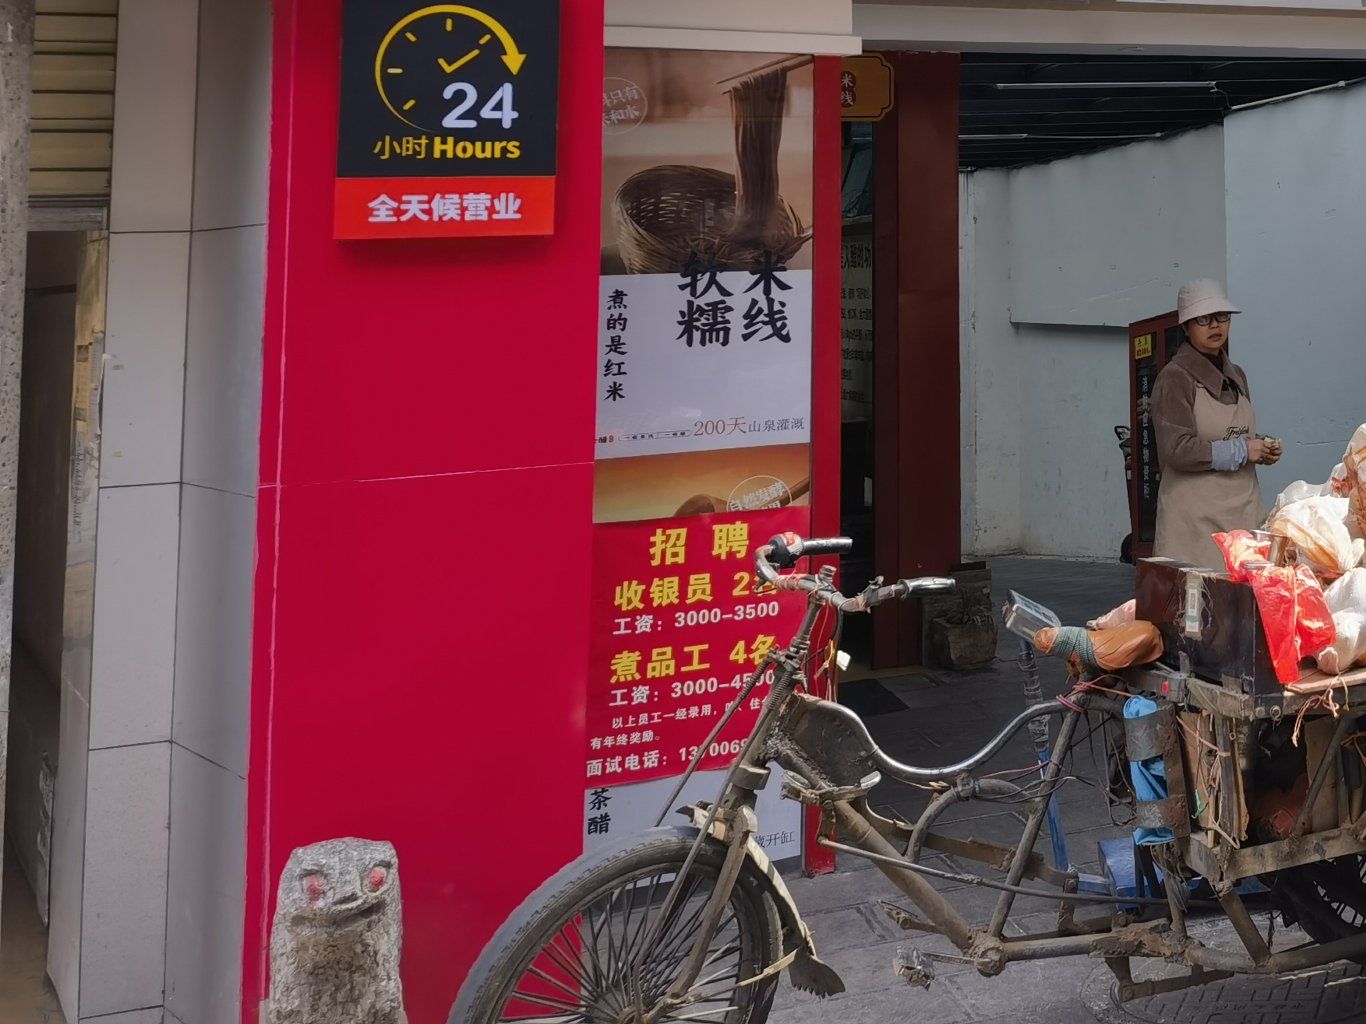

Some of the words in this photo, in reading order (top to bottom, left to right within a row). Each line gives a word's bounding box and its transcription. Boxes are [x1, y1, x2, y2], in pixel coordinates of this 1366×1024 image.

[441, 82, 519, 129] 24
[373, 135, 429, 159] 小时
[433, 136, 521, 159] Hours
[367, 192, 522, 222] 全天候营业
[603, 288, 629, 402] 煮的是红米
[649, 520, 750, 567] 招聘
[614, 573, 713, 612] 收银员
[609, 643, 711, 684] 煮品工
[586, 787, 613, 836] 茶醋
